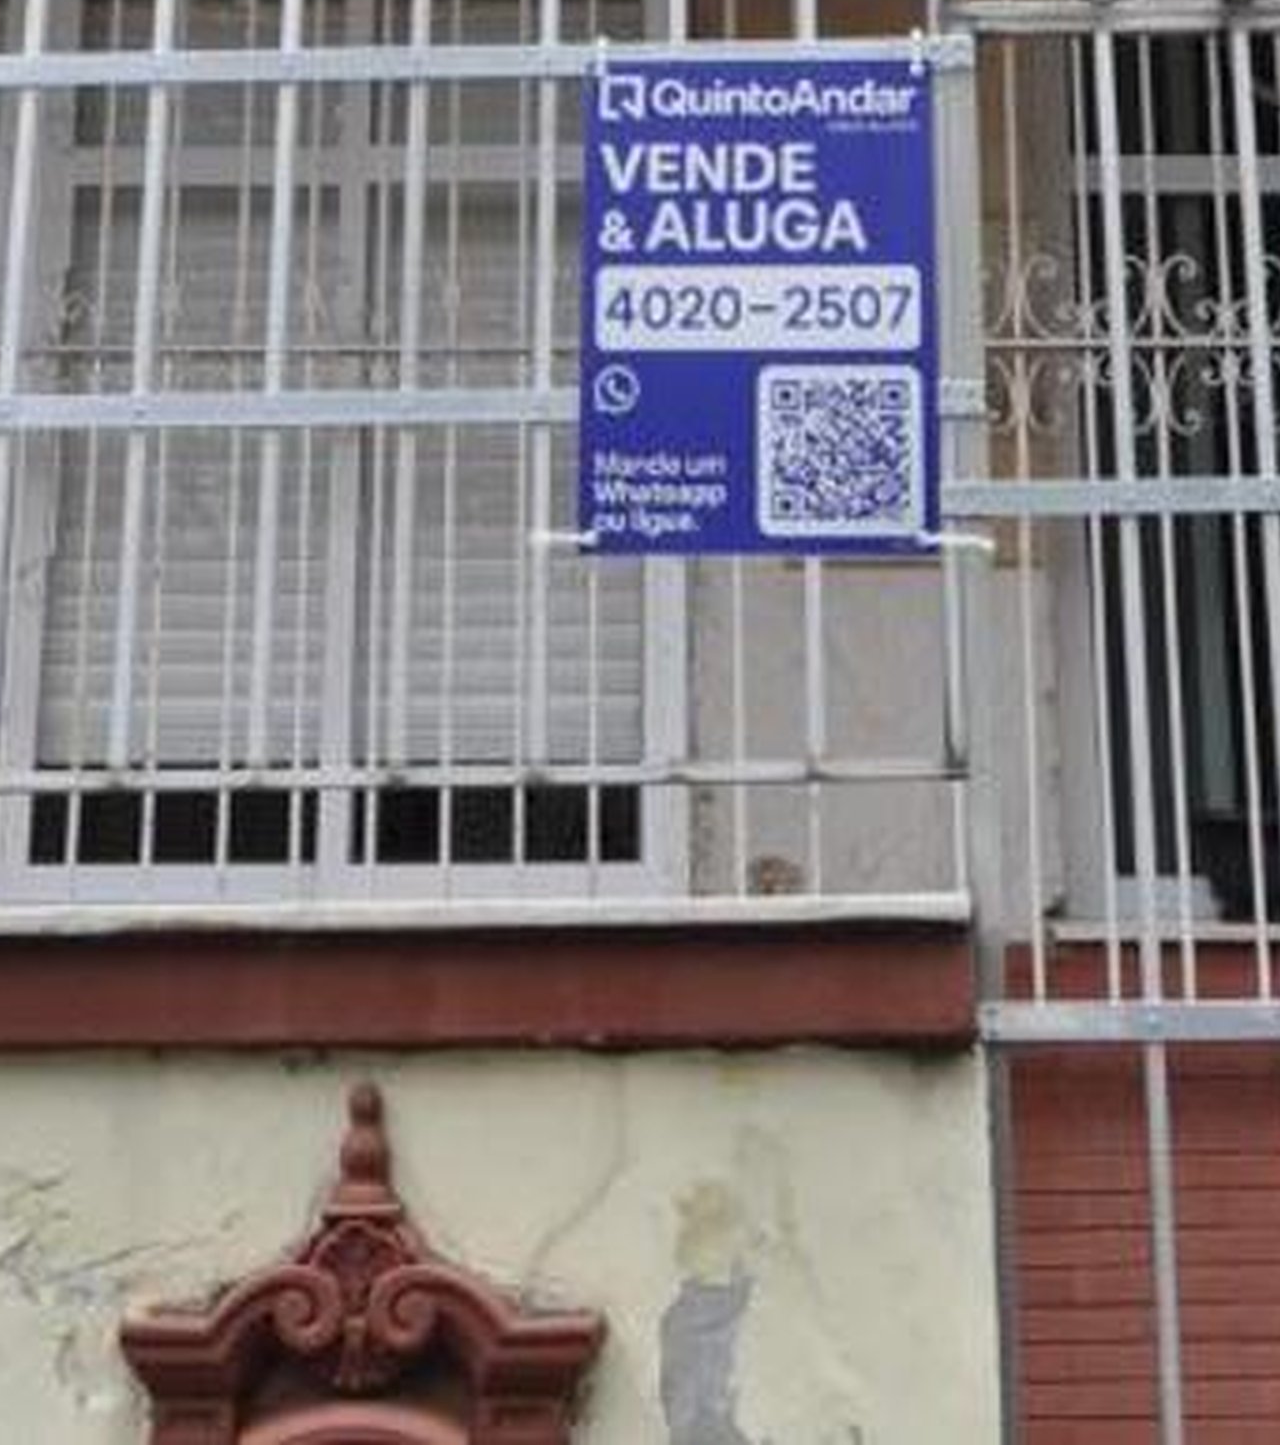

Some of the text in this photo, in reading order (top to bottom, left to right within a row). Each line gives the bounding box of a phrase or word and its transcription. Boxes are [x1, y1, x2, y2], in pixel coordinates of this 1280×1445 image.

[651, 77, 915, 116] QuintoAndar
[600, 142, 817, 192] VENDE
[598, 199, 868, 253] & ALUGA
[605, 283, 912, 331] 4020-2507
